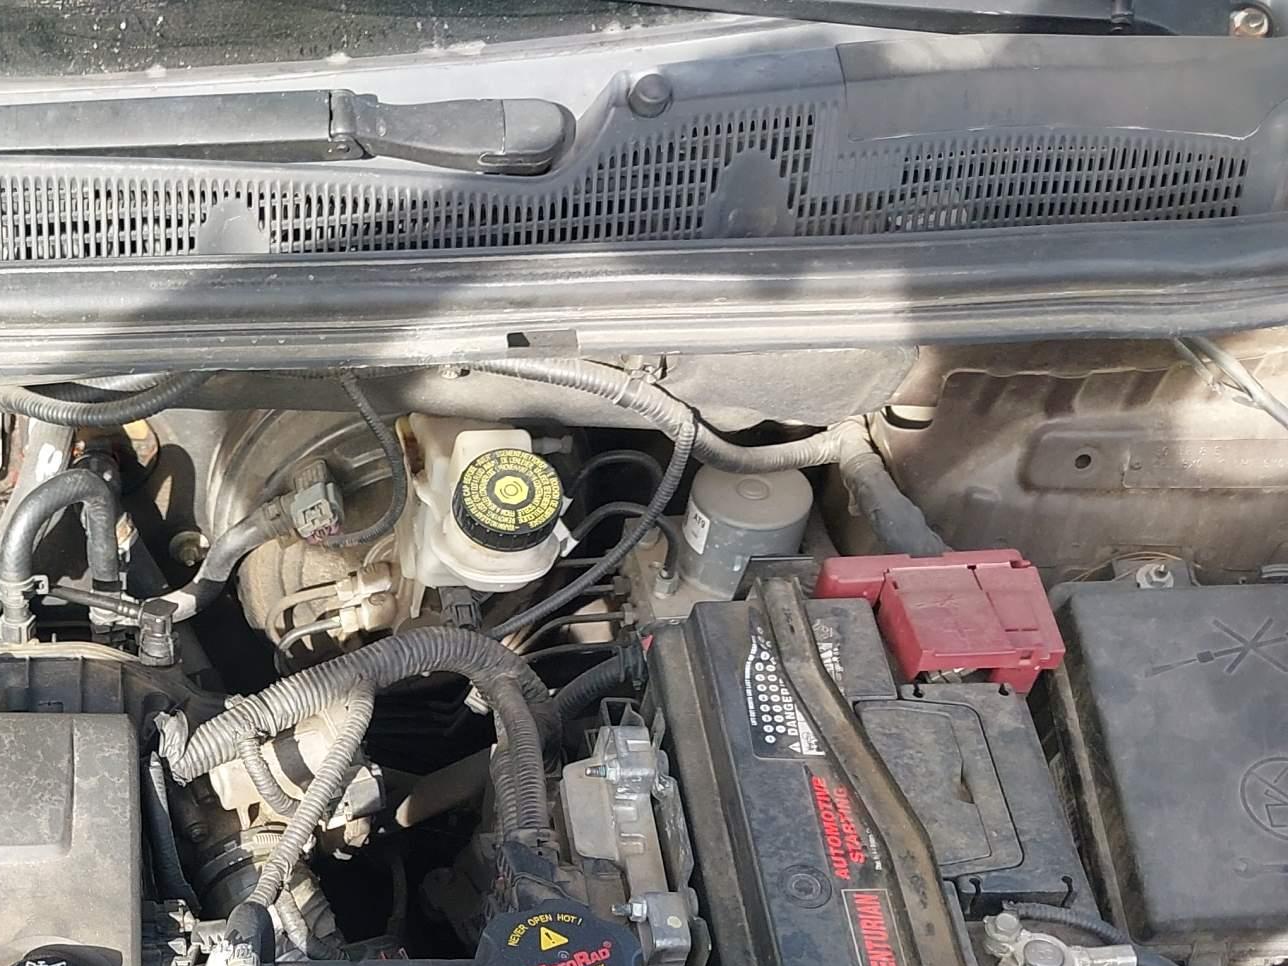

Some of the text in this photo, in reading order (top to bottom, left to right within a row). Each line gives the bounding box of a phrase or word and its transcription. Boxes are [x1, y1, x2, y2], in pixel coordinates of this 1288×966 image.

[812, 776, 850, 880] AUTOMOTIVE
[833, 784, 866, 864] STARTING
[507, 924, 528, 947] NEVER
[527, 913, 552, 926] OPEN
